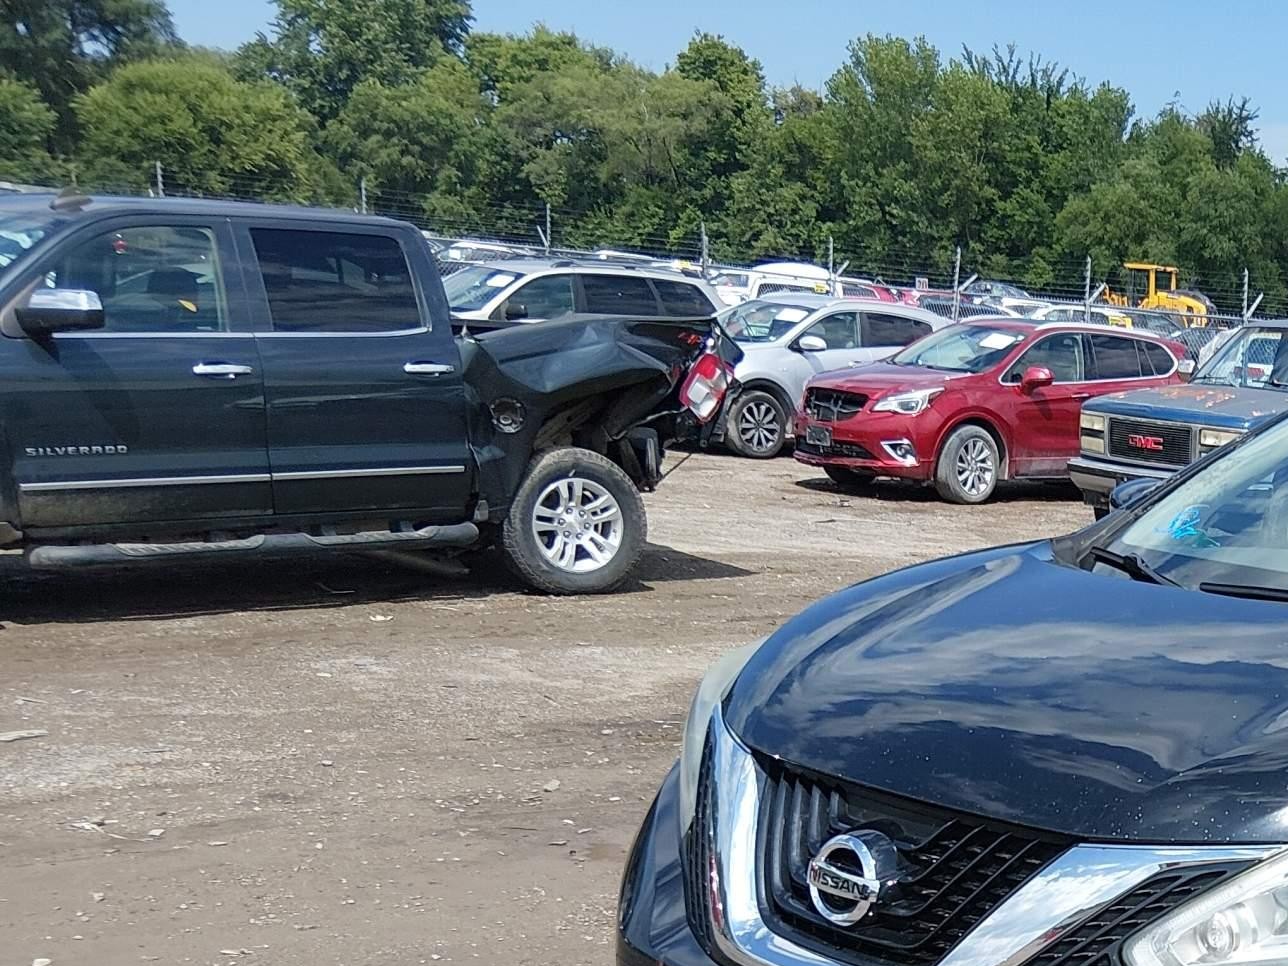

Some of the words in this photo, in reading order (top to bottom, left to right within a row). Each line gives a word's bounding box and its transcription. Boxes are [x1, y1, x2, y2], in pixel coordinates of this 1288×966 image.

[25, 445, 128, 457] SILVERADO
[1127, 434, 1164, 451] GMC
[811, 868, 867, 898] NISSAN
